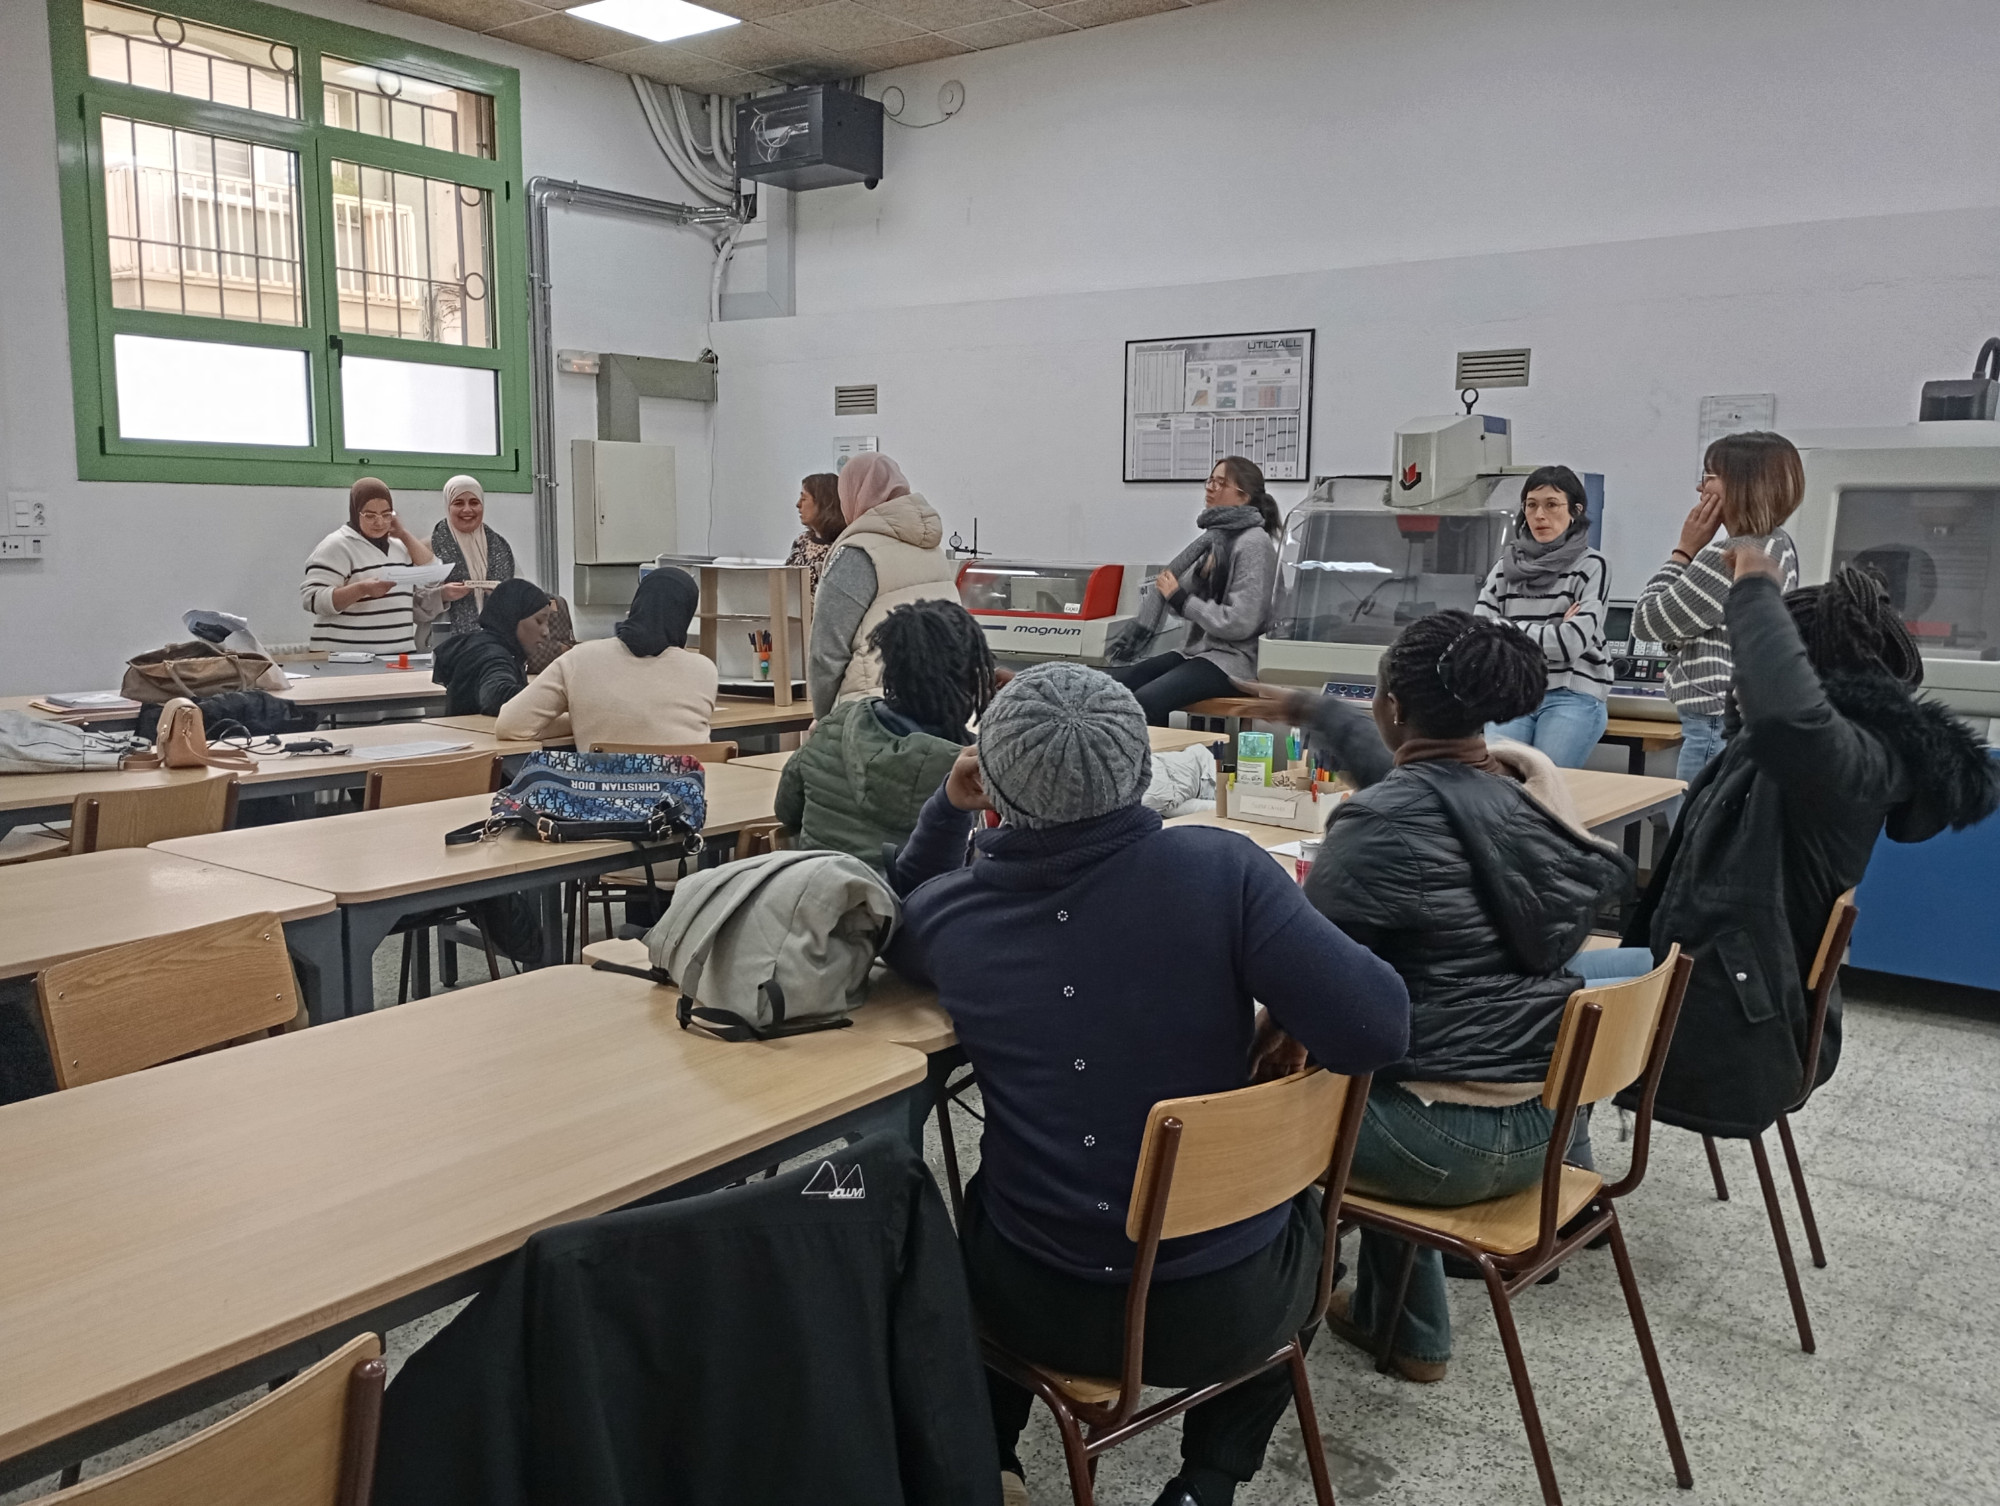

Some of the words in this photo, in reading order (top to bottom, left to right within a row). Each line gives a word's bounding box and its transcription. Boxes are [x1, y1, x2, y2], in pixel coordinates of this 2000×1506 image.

[1247, 339, 1301, 350] UTILTALL
[1013, 625, 1081, 636] magnum
[571, 780, 596, 791] DIOR
[602, 782, 660, 791] CHRISTIAN
